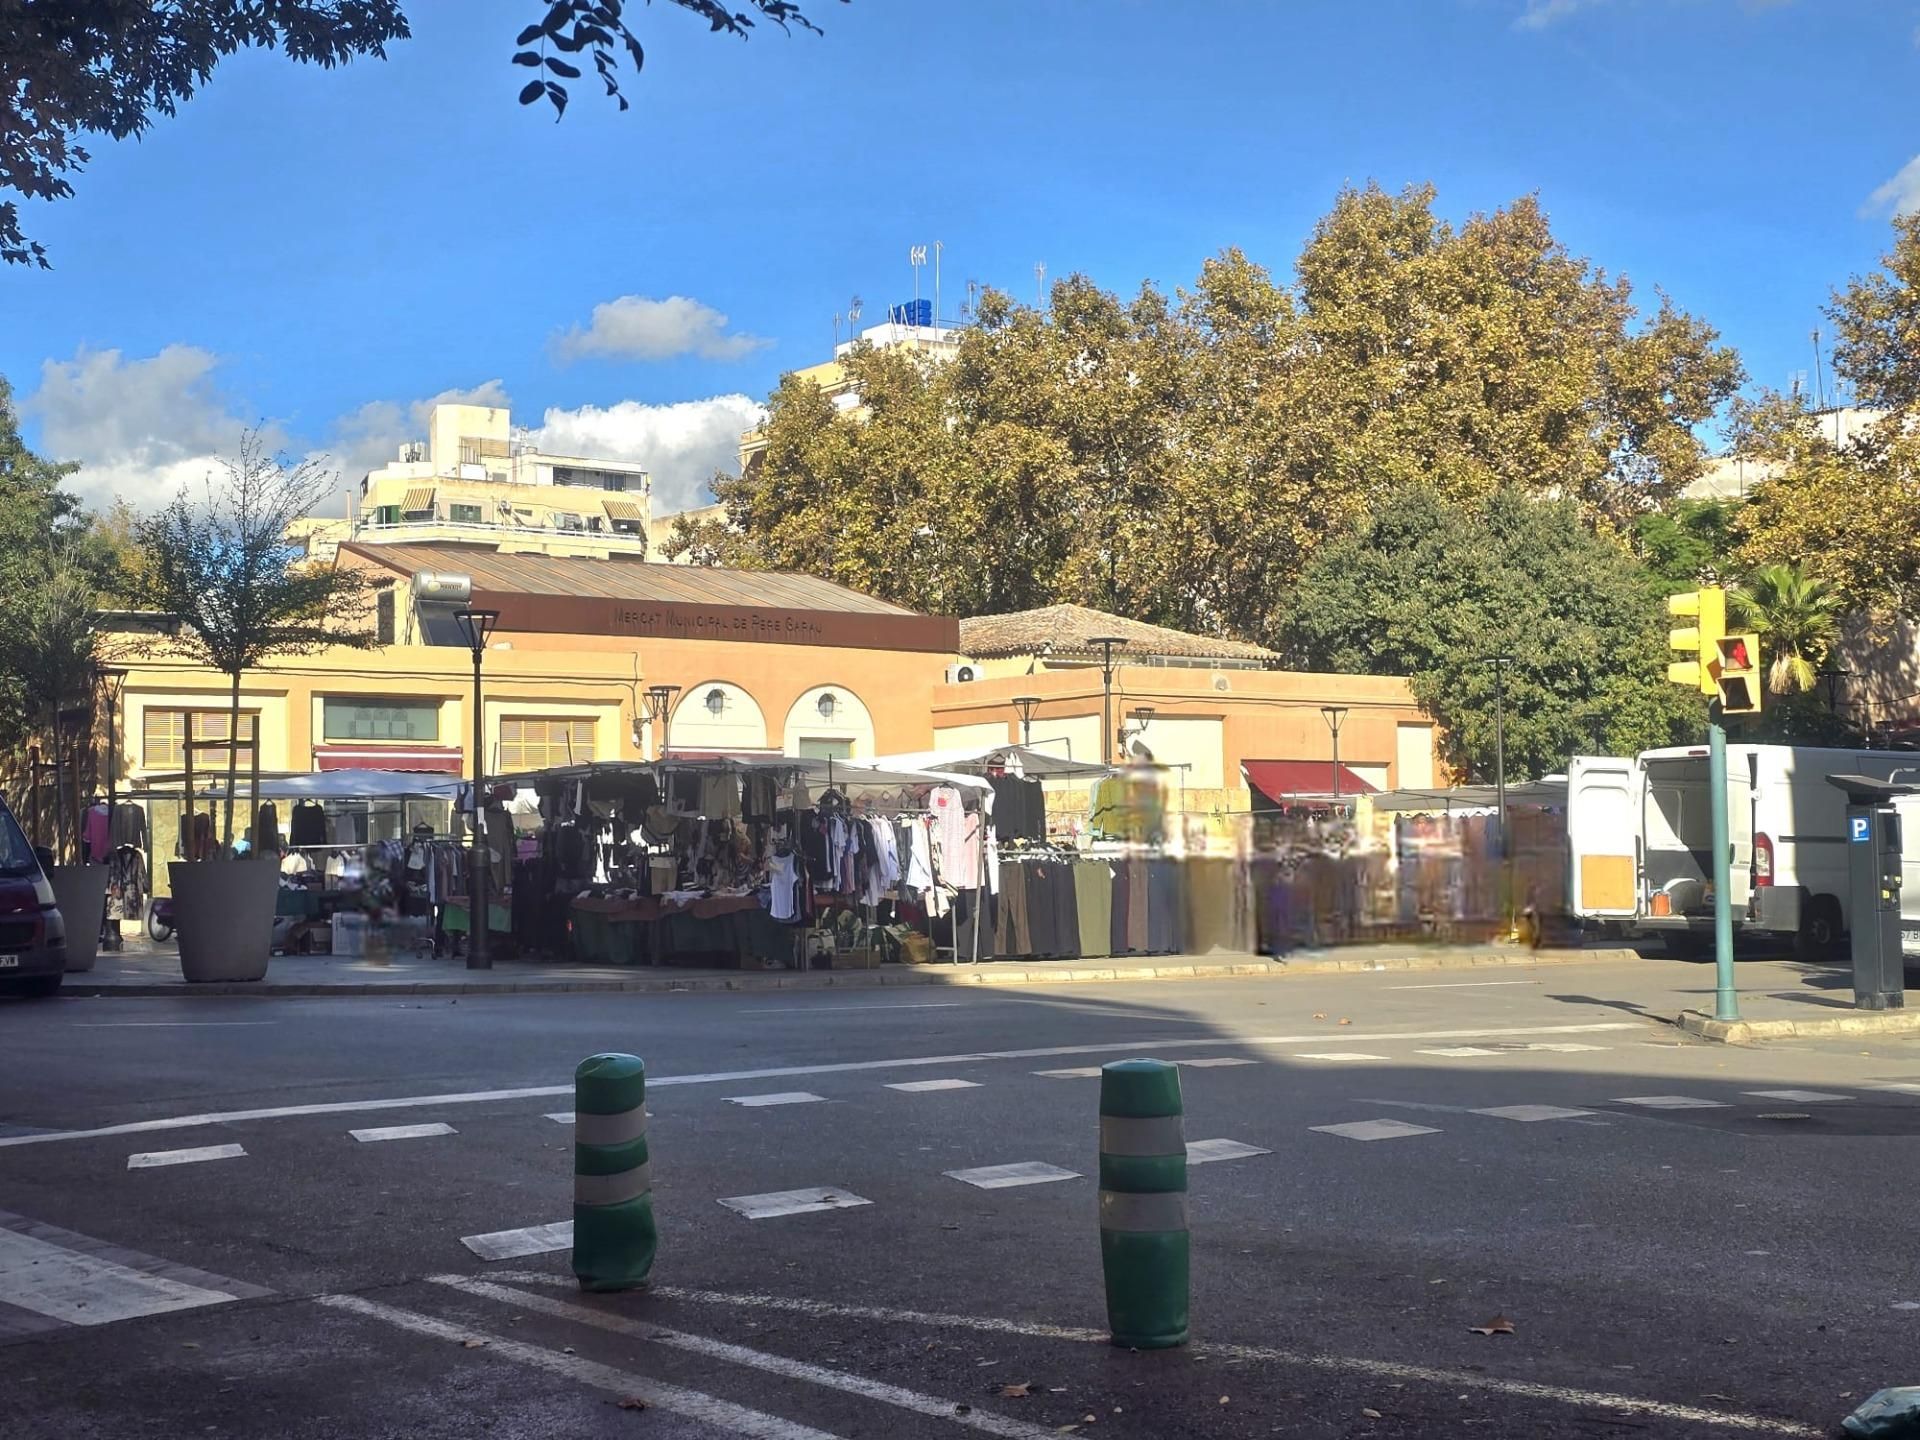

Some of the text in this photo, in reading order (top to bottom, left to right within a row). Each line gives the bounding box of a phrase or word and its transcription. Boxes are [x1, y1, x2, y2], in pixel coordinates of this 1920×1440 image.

[614, 607, 823, 634] MERCAT MUNICIPAL DE PERE GARAU
[1854, 819, 1867, 838] P
